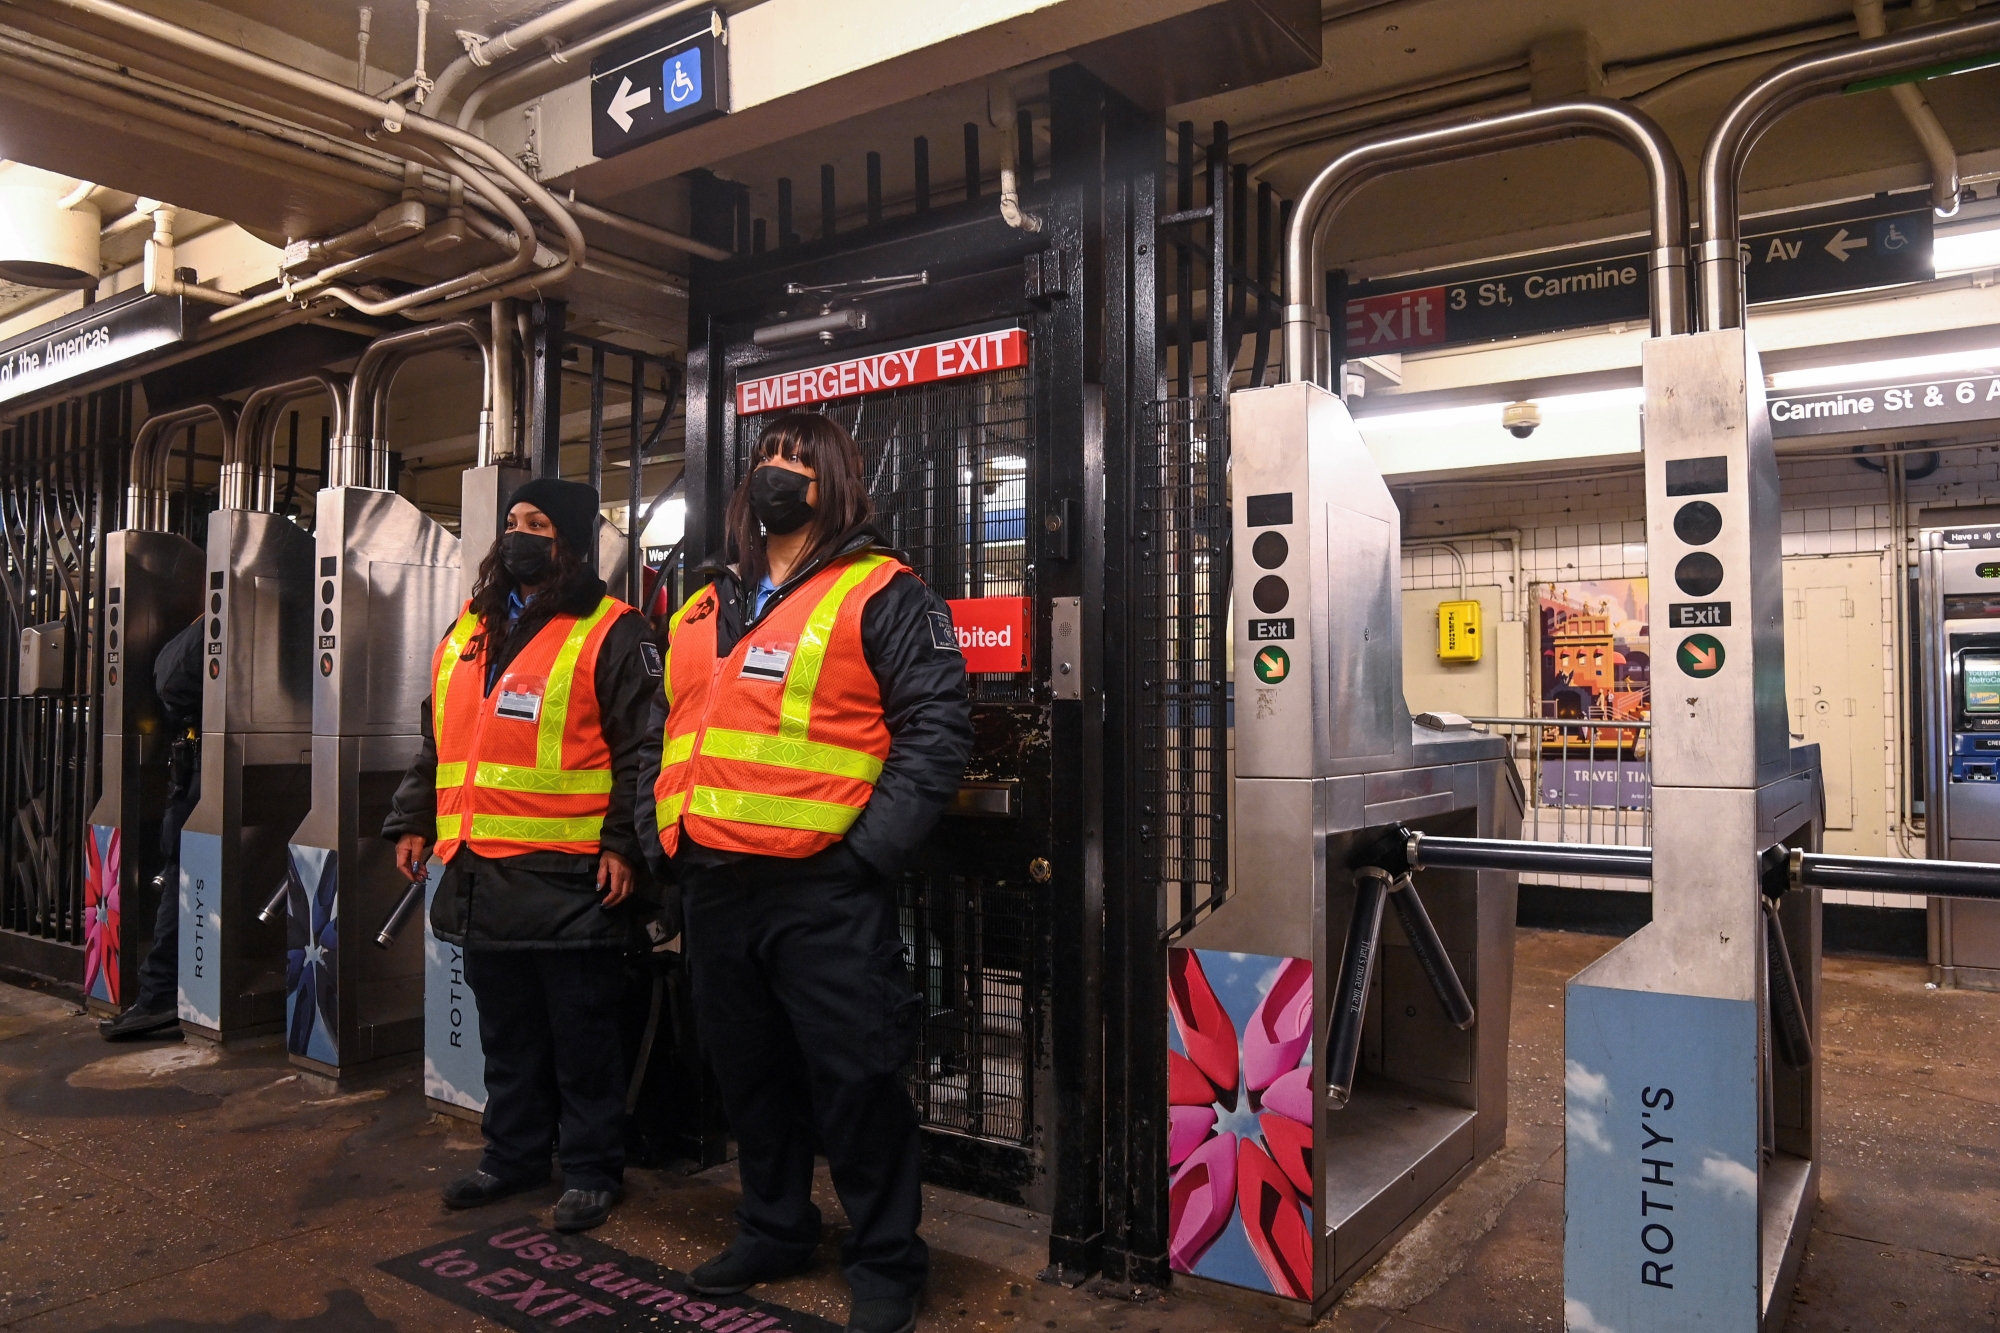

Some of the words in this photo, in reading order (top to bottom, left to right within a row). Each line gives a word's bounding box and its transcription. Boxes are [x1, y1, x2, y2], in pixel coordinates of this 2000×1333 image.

[1739, 243, 1752, 266] 6
[1765, 238, 1803, 264] Av
[1346, 295, 1433, 348] Exit
[1450, 288, 1467, 311] 3
[1478, 283, 1513, 307] St,
[1524, 266, 1638, 299] Carmine
[1, 356, 14, 383] of
[18, 350, 40, 376] the
[45, 325, 109, 368] Americas
[742, 349, 920, 414] EMERGENCY
[936, 332, 1011, 377] EXIT
[1771, 394, 1875, 422] Carmine
[1884, 389, 1914, 411] St
[1924, 385, 1944, 407] &
[1955, 382, 1976, 404] 6
[649, 547, 673, 562] Wes
[1951, 533, 1973, 541] Have
[1257, 621, 1288, 638] Exit
[1680, 605, 1721, 625] Exit
[211, 644, 221, 655] Exit
[322, 637, 334, 648] Exit
[195, 878, 205, 979] ROTHY'S
[450, 947, 464, 1048] ROTHY
[1641, 1086, 1675, 1290] ROTHY'S
[418, 1248, 479, 1278] to
[464, 1267, 617, 1328] EXIT
[487, 1226, 583, 1271] Use
[573, 1260, 796, 1333] turnstil
